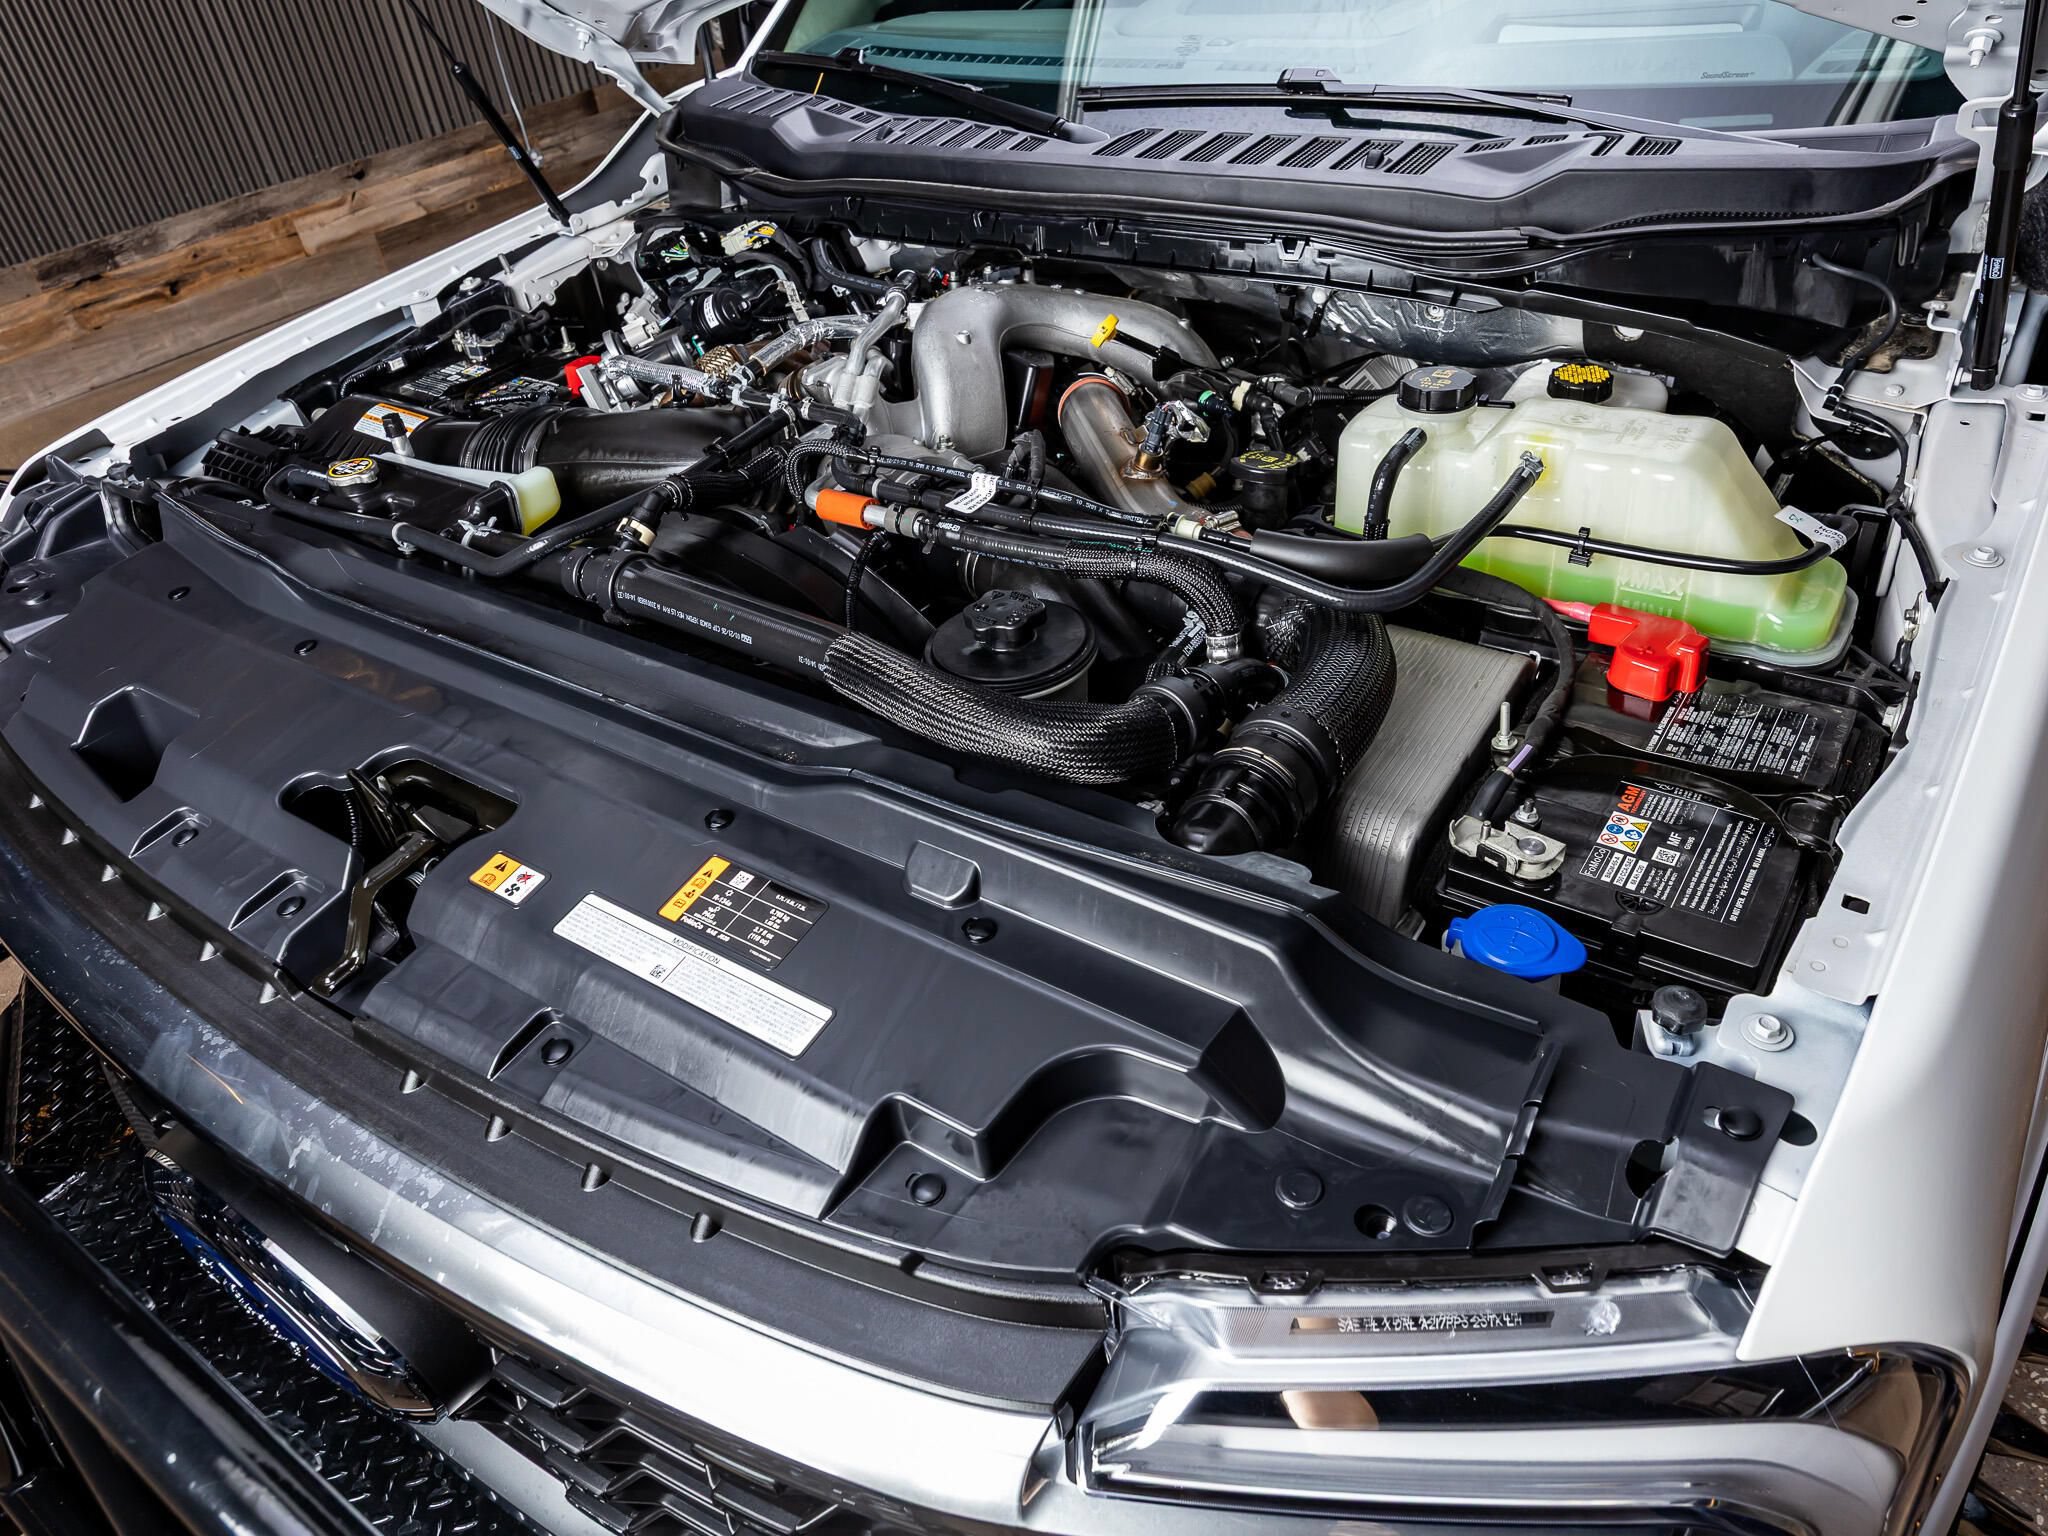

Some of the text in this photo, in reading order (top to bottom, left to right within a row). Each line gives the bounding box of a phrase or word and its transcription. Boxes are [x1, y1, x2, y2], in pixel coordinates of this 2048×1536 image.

[1631, 571, 1685, 597] MAX
[1615, 784, 1641, 812] AGM
[1666, 830, 1683, 846] MF
[1584, 846, 1606, 877] FoMoCo
[711, 893, 734, 907] R-134a
[679, 915, 705, 930] FoMoCo
[704, 927, 718, 936] SAE
[671, 936, 721, 966] MODIFICATION
[1337, 1317, 1361, 1333] SAE
